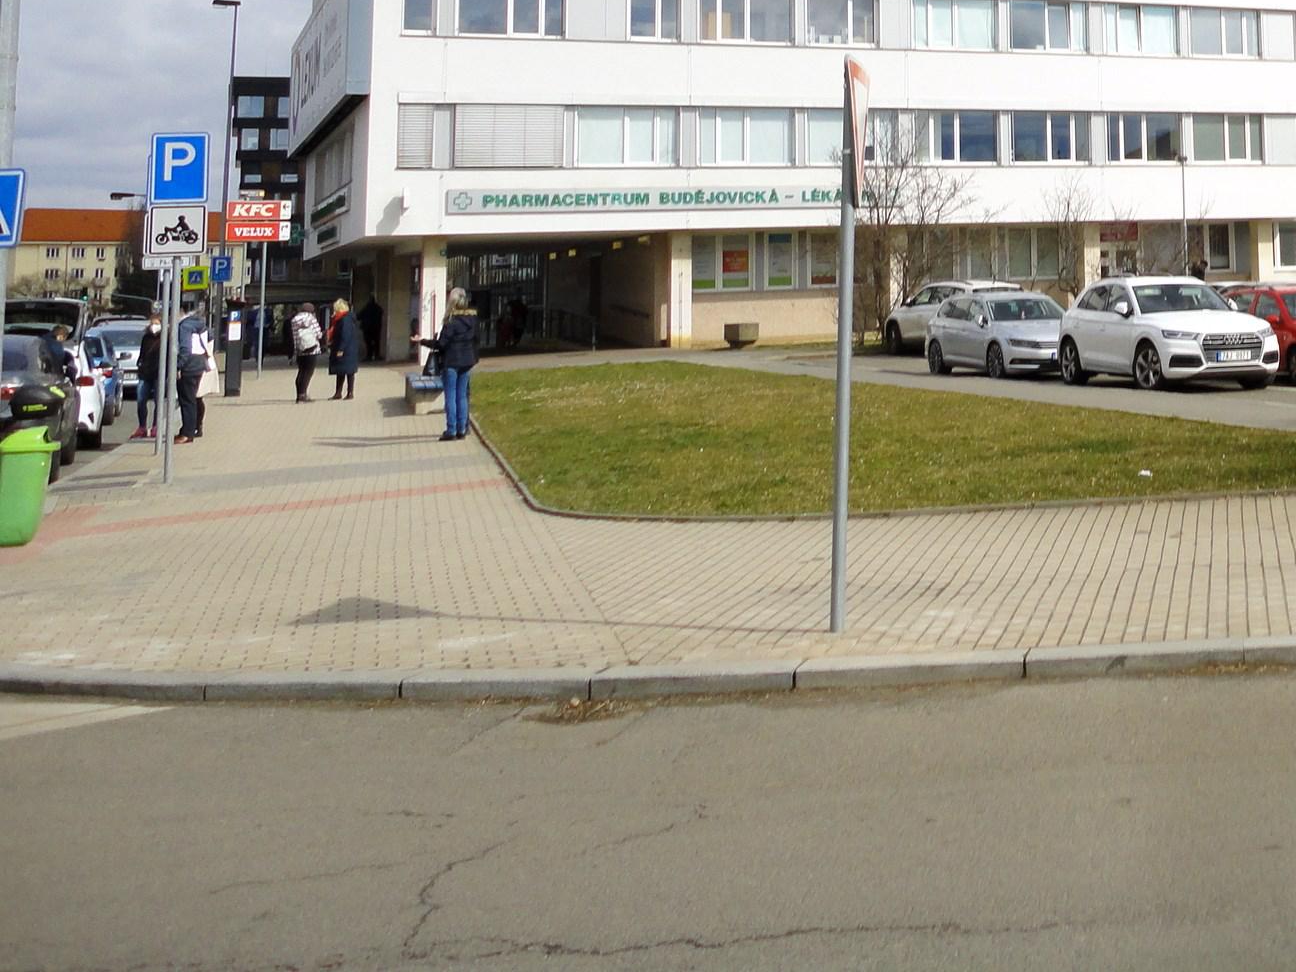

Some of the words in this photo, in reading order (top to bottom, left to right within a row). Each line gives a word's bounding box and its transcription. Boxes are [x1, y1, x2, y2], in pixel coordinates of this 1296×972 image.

[163, 141, 197, 181] P
[482, 192, 650, 208] PHARMACENTRUM
[232, 203, 275, 217] KFC
[234, 227, 273, 237] VELUX
[214, 258, 228, 275] P
